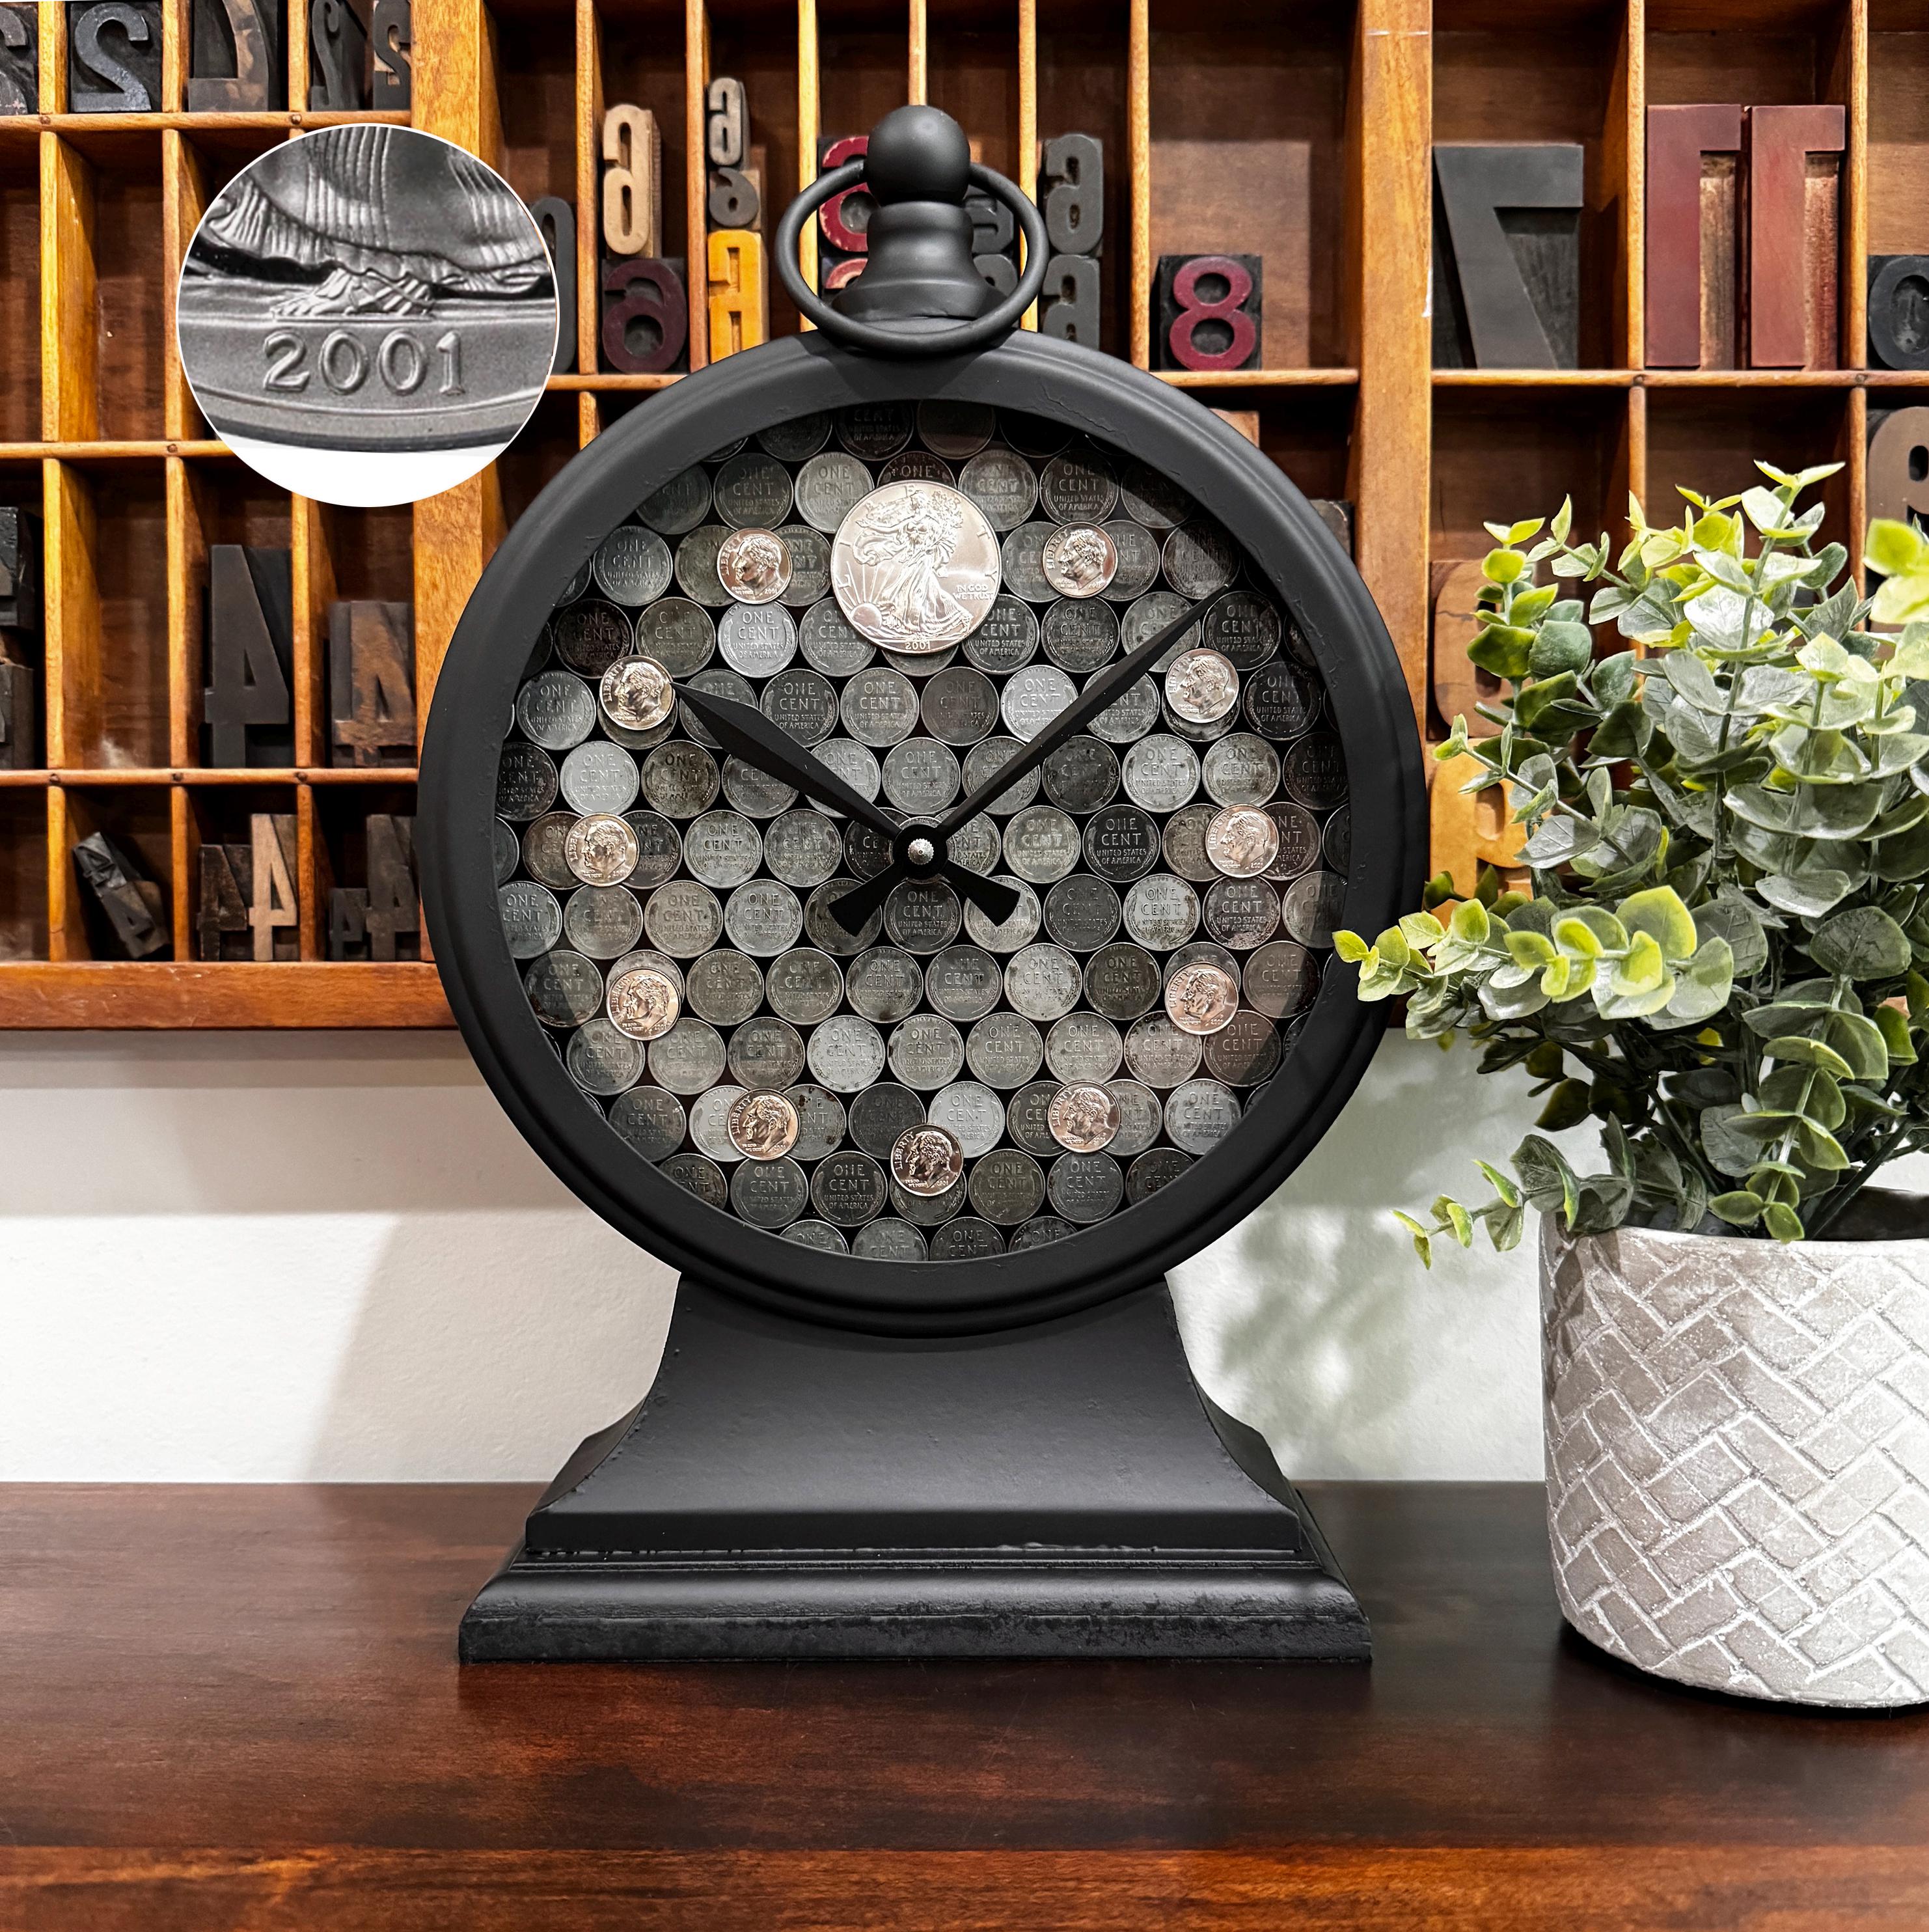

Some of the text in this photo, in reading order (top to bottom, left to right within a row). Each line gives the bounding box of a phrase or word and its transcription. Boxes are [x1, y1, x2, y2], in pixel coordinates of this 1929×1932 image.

[1170, 256, 1256, 372] 8
[818, 465, 849, 478] ONE
[1063, 464, 1095, 475] ONE
[814, 483, 854, 494] CENT
[1059, 480, 1097, 491] CENT
[618, 542, 648, 552] ONE
[1047, 529, 1069, 570] LIBERTY
[720, 533, 743, 575] LIBERTY
[613, 557, 653, 568] CENT
[743, 612, 774, 624] ONE
[989, 608, 1017, 620] ONE
[738, 628, 778, 639] CENT
[983, 624, 1020, 636] CENT
[605, 662, 625, 702] LIBERTY
[1025, 679, 1055, 691] ONE
[784, 683, 815, 695] ONE
[780, 699, 820, 710] CENT
[1020, 695, 1060, 706] CENT
[1146, 747, 1177, 759] ONE
[584, 755, 615, 766] ONE
[1141, 763, 1181, 775] CENT
[580, 770, 619, 782] CENT
[707, 824, 739, 836] ONE
[1106, 818, 1137, 830] ONE
[1209, 812, 1233, 851] LIBERTY
[568, 822, 588, 862] LIBERTY
[704, 840, 743, 851] CENT
[1101, 834, 1142, 846] CENT
[907, 891, 938, 902] ONE
[1145, 888, 1177, 900] ONE
[1227, 885, 1257, 898] ONE
[748, 894, 778, 905] ONE
[903, 906, 943, 917] CENT
[1142, 904, 1181, 915] CENT
[1222, 902, 1261, 913] CENT
[744, 909, 783, 920] CENT
[1029, 958, 1058, 970] ONE
[1024, 973, 1063, 984] CENT
[612, 976, 631, 1014] LIBERTY
[1169, 971, 1191, 1008] LIBERTY
[989, 1026, 1019, 1037] ONE
[1068, 1026, 1098, 1037] ONE
[1227, 1024, 1258, 1035] ONE
[985, 1041, 1025, 1053] CENT
[1064, 1041, 1103, 1052] CENT
[1223, 1040, 1263, 1051] CENT
[951, 1095, 982, 1107] ONE
[1188, 1092, 1219, 1103] ONE
[1052, 1088, 1073, 1127] LIBERTY
[1184, 1107, 1223, 1119] CENT
[733, 1096, 751, 1135] LIBERTY
[948, 1110, 987, 1121] CENT
[894, 1131, 914, 1170] LIBERTY
[834, 1164, 865, 1176] ONE
[830, 1180, 869, 1191] CENT
[953, 1230, 983, 1241] ONE
[948, 1245, 987, 1257] CENT
